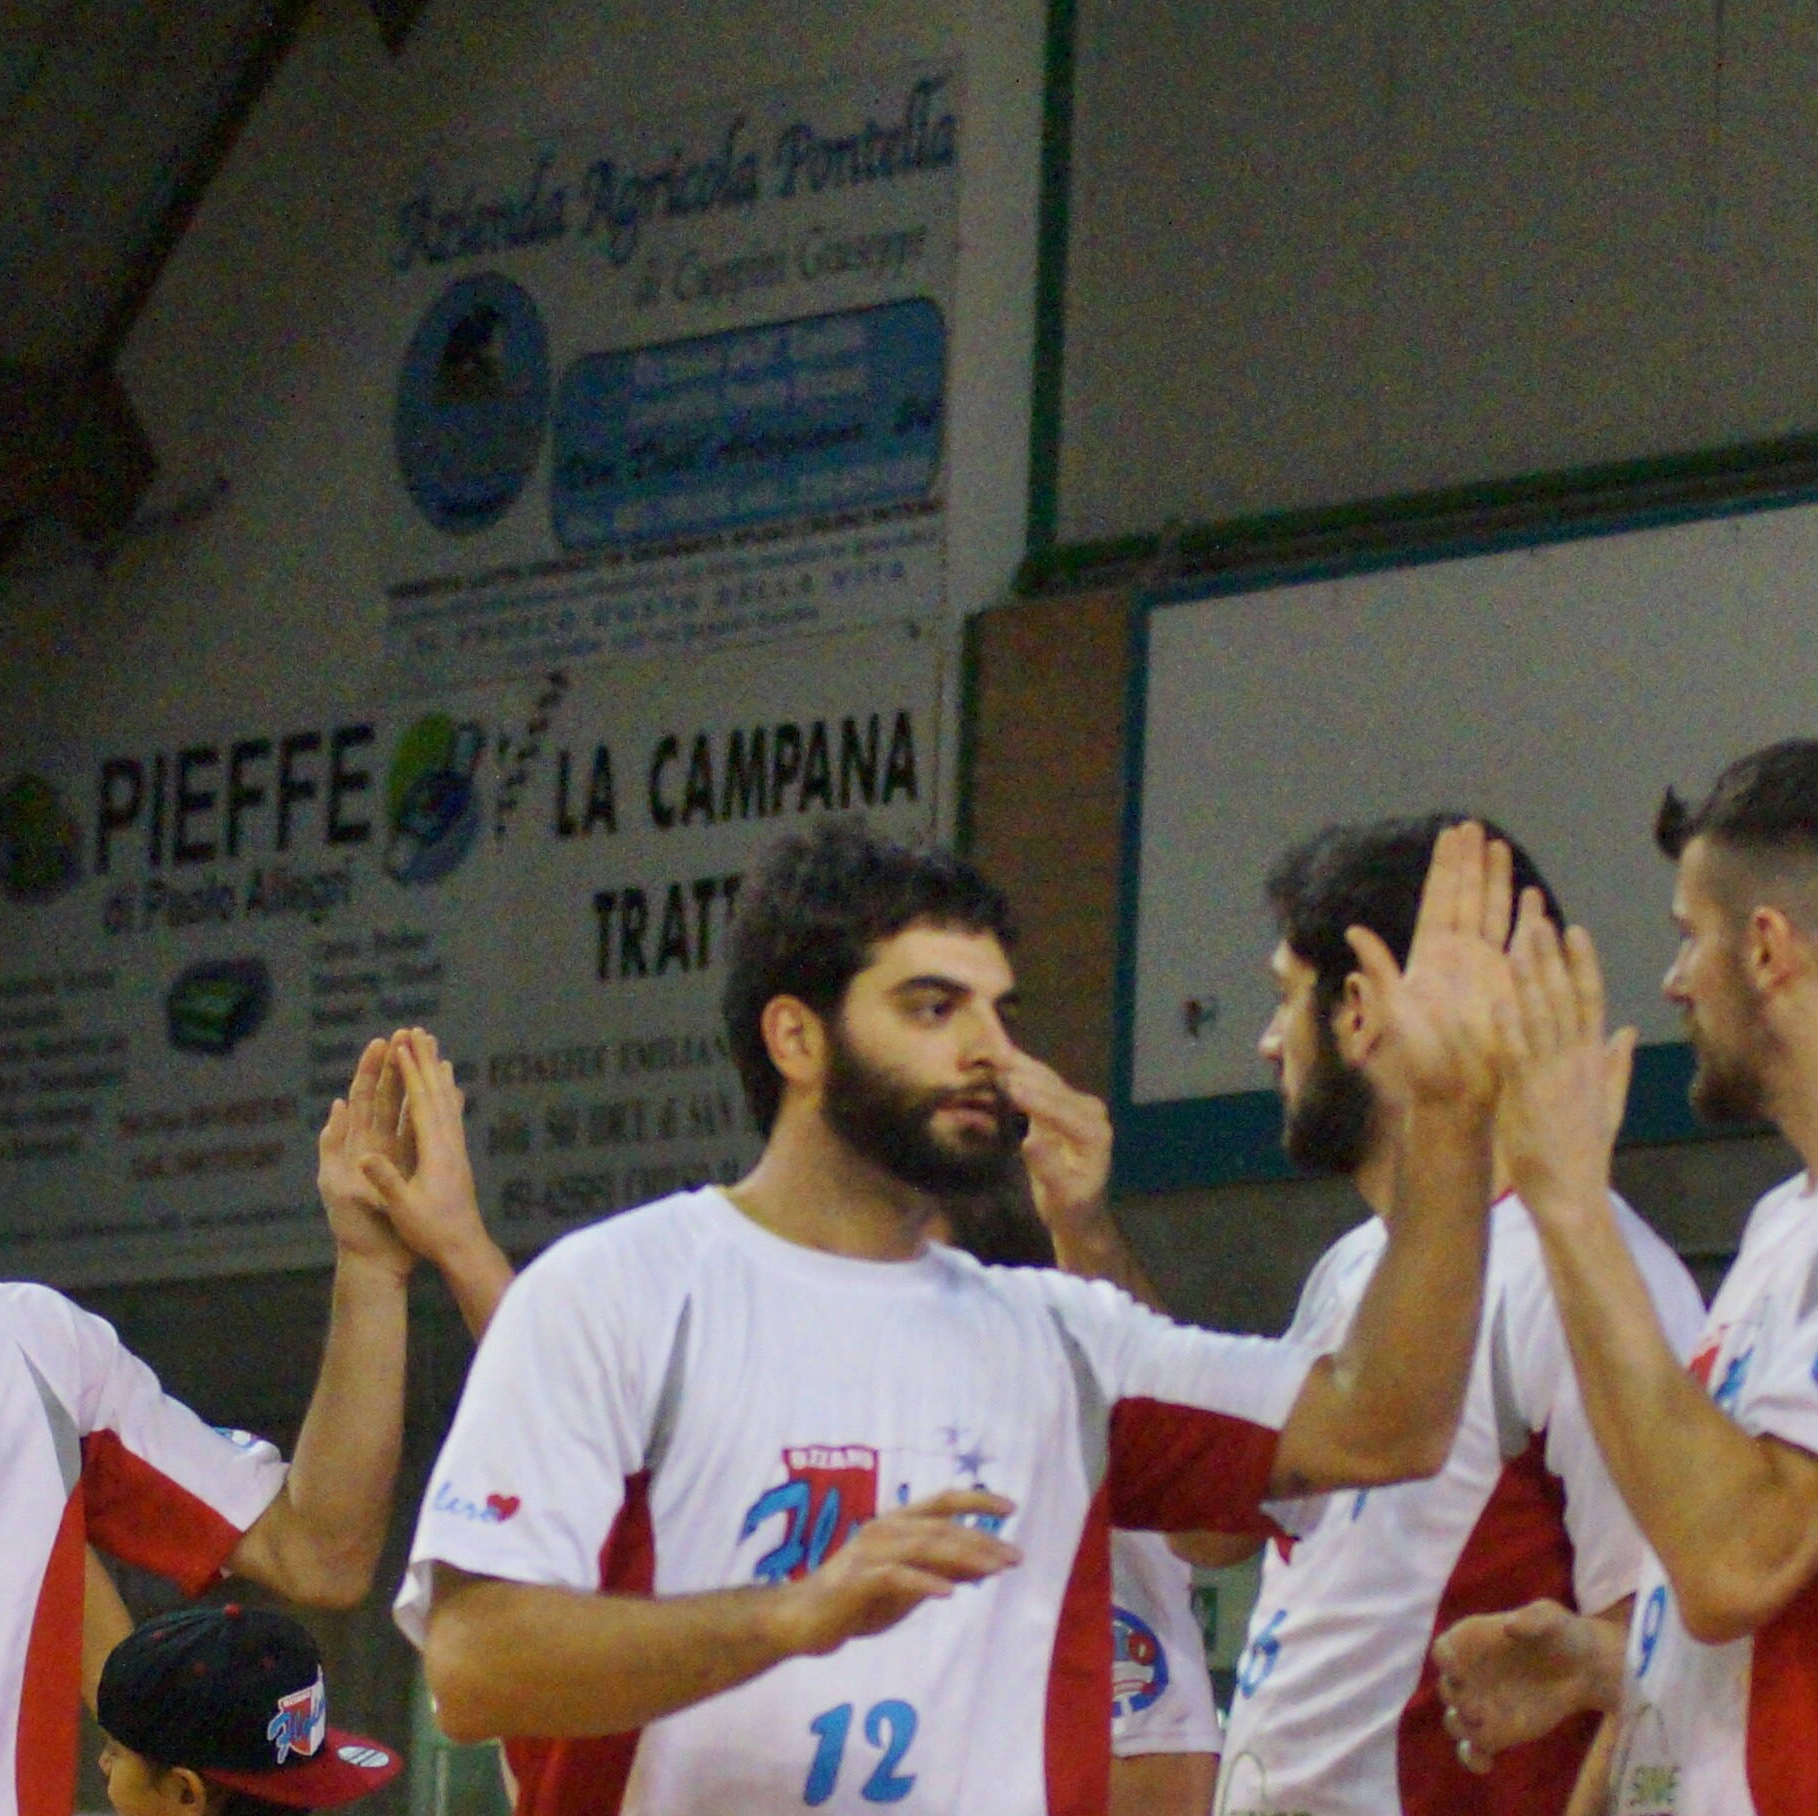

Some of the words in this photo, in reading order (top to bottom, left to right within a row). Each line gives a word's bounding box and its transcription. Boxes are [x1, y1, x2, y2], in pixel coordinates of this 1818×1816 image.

[93, 721, 377, 875] PIEFFE
[555, 742, 619, 838] LA
[647, 708, 919, 828] CAMPANA
[804, 1698, 920, 1808] 12
